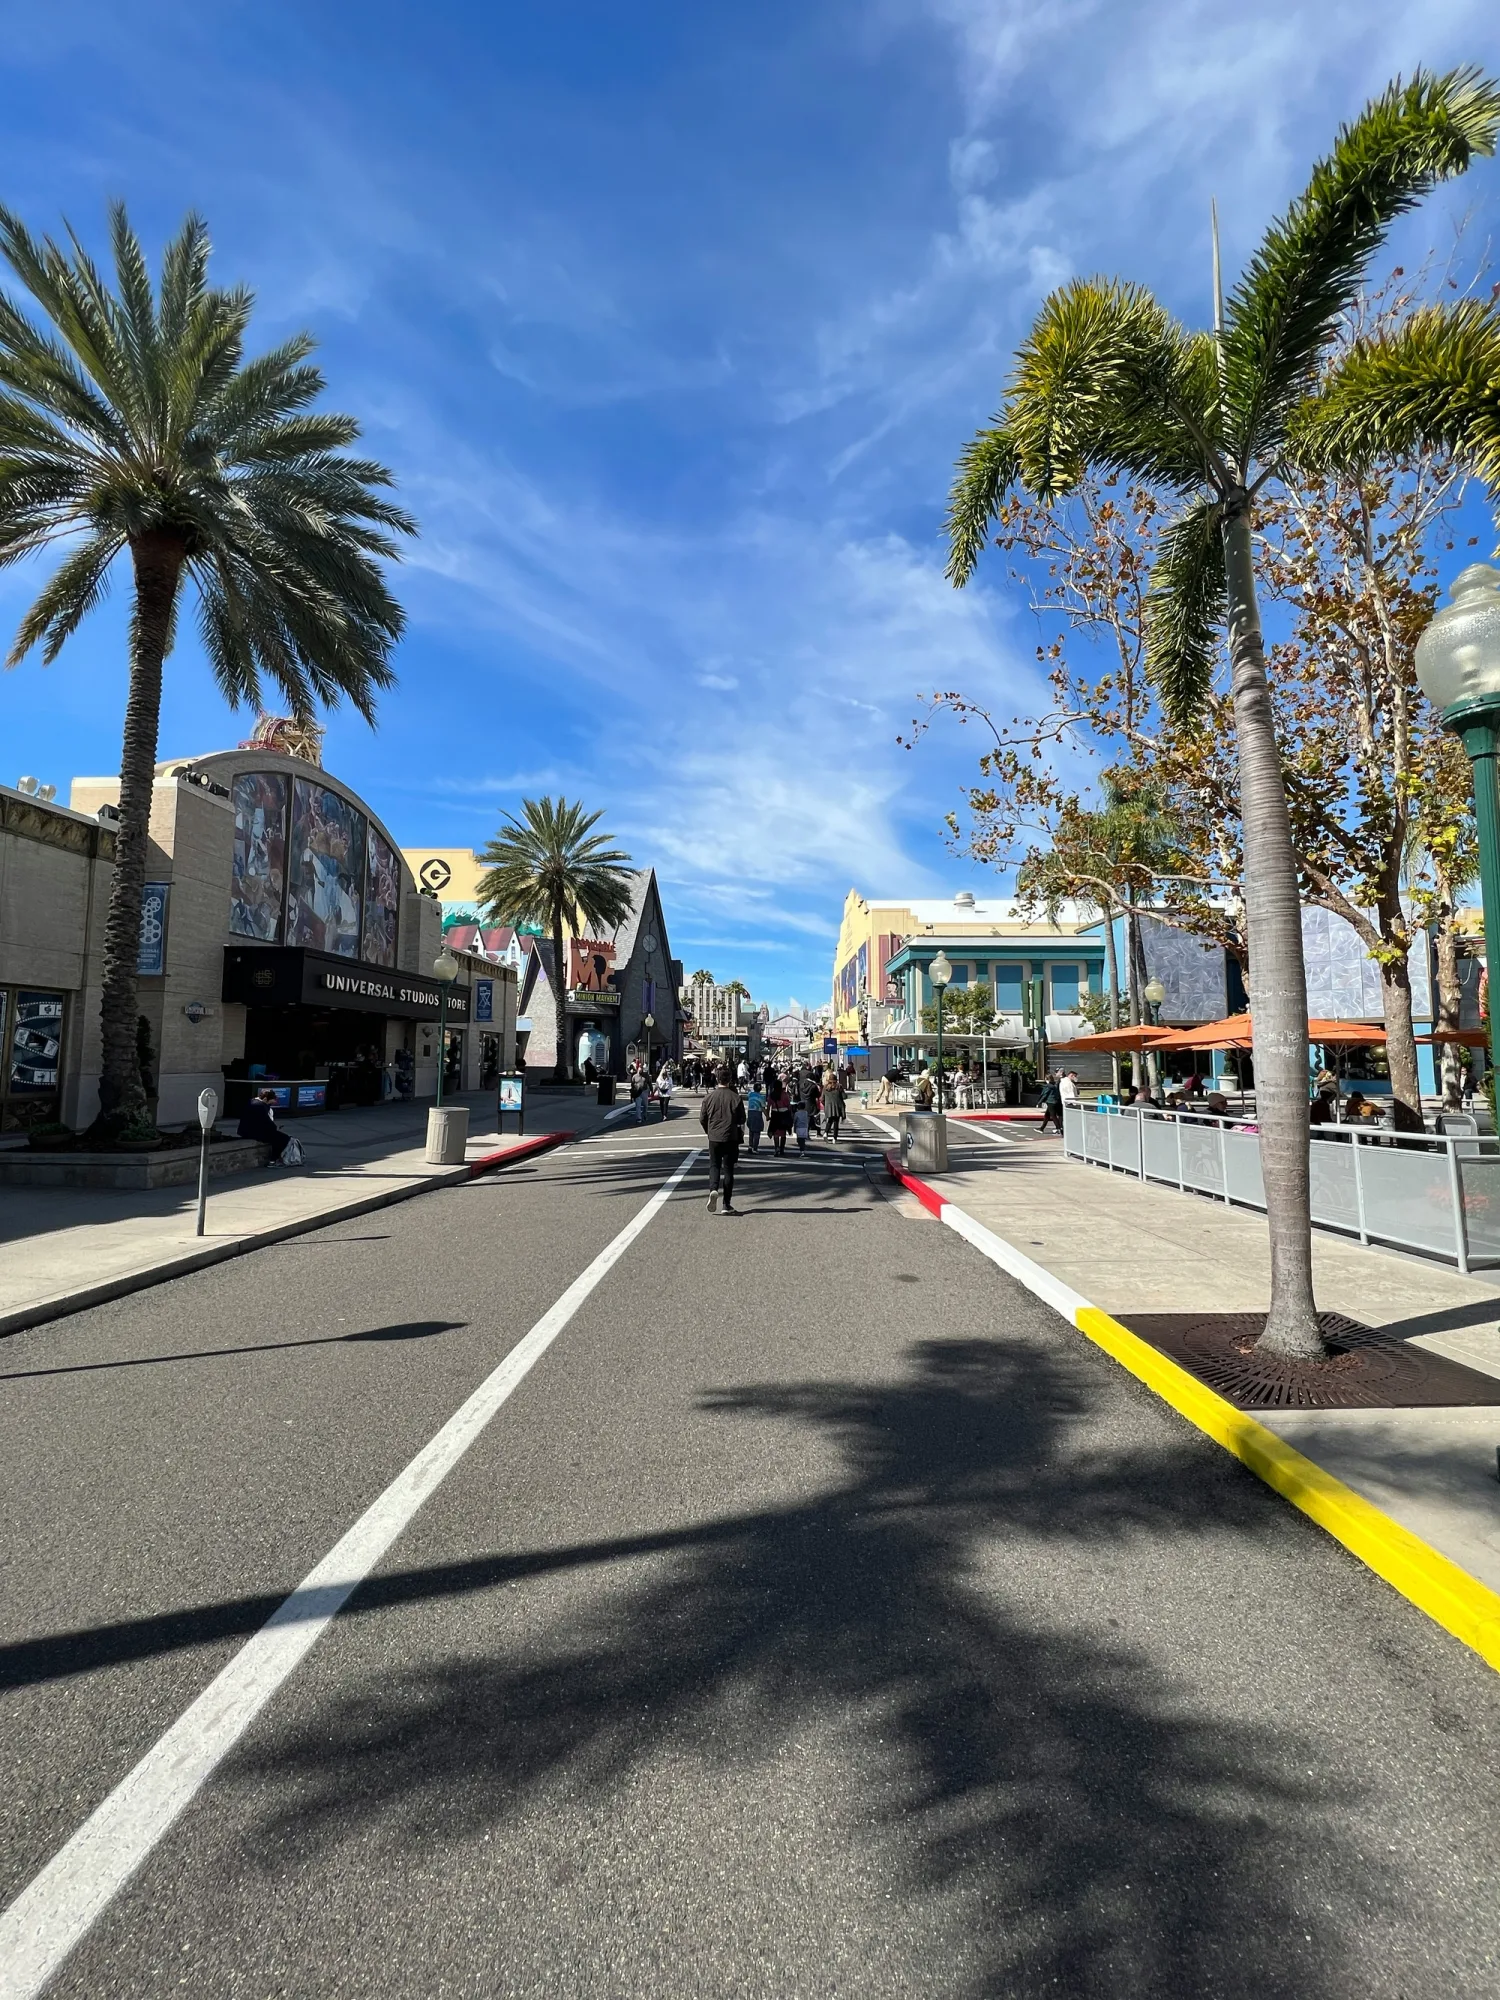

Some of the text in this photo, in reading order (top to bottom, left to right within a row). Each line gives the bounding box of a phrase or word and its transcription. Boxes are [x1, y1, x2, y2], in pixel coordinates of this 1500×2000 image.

[326, 973, 466, 1010] UNIVERSAL STUDIOS TORE
[595, 994, 618, 1003] MAYHEM
